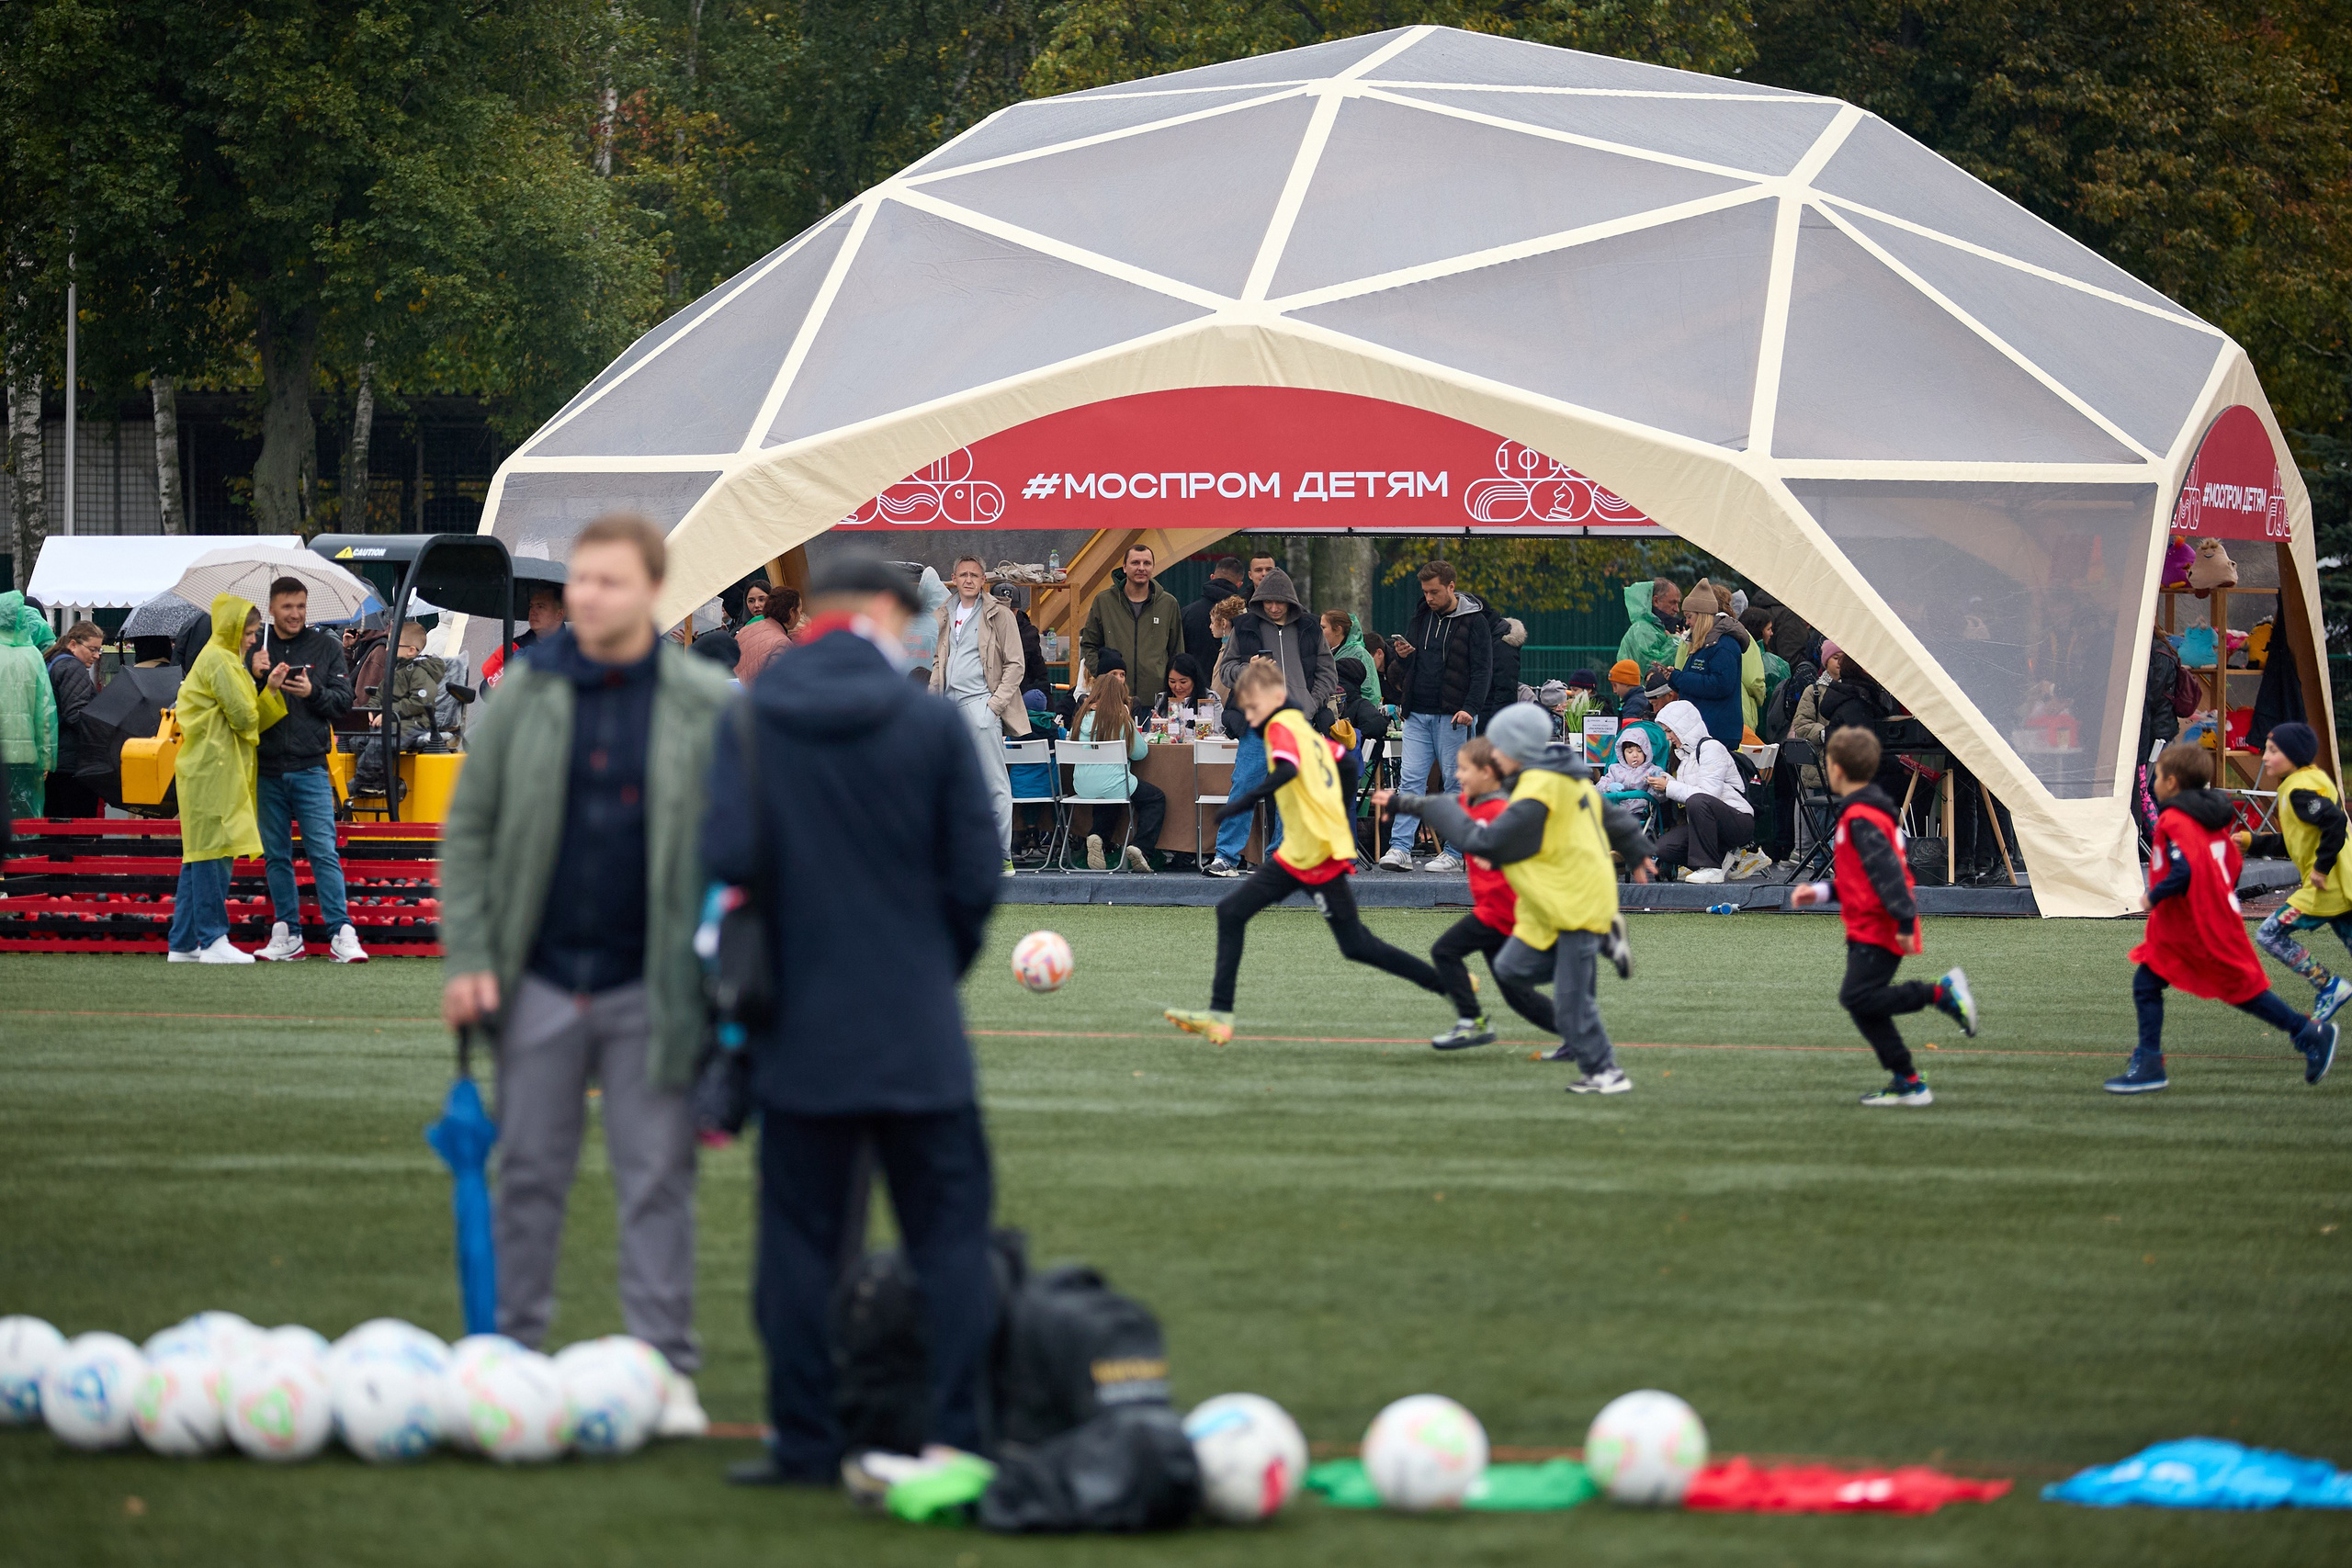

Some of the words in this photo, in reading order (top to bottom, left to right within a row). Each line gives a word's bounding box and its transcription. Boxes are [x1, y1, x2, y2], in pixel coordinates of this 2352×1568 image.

[1021, 472, 1281, 500] #МОСПРОМ
[1293, 471, 1449, 502] ДЕТЯМ
[2202, 482, 2243, 511] #МОСПРОМ
[2242, 486, 2267, 514] ДЕТЯМ
[353, 547, 387, 557] CAUTION
